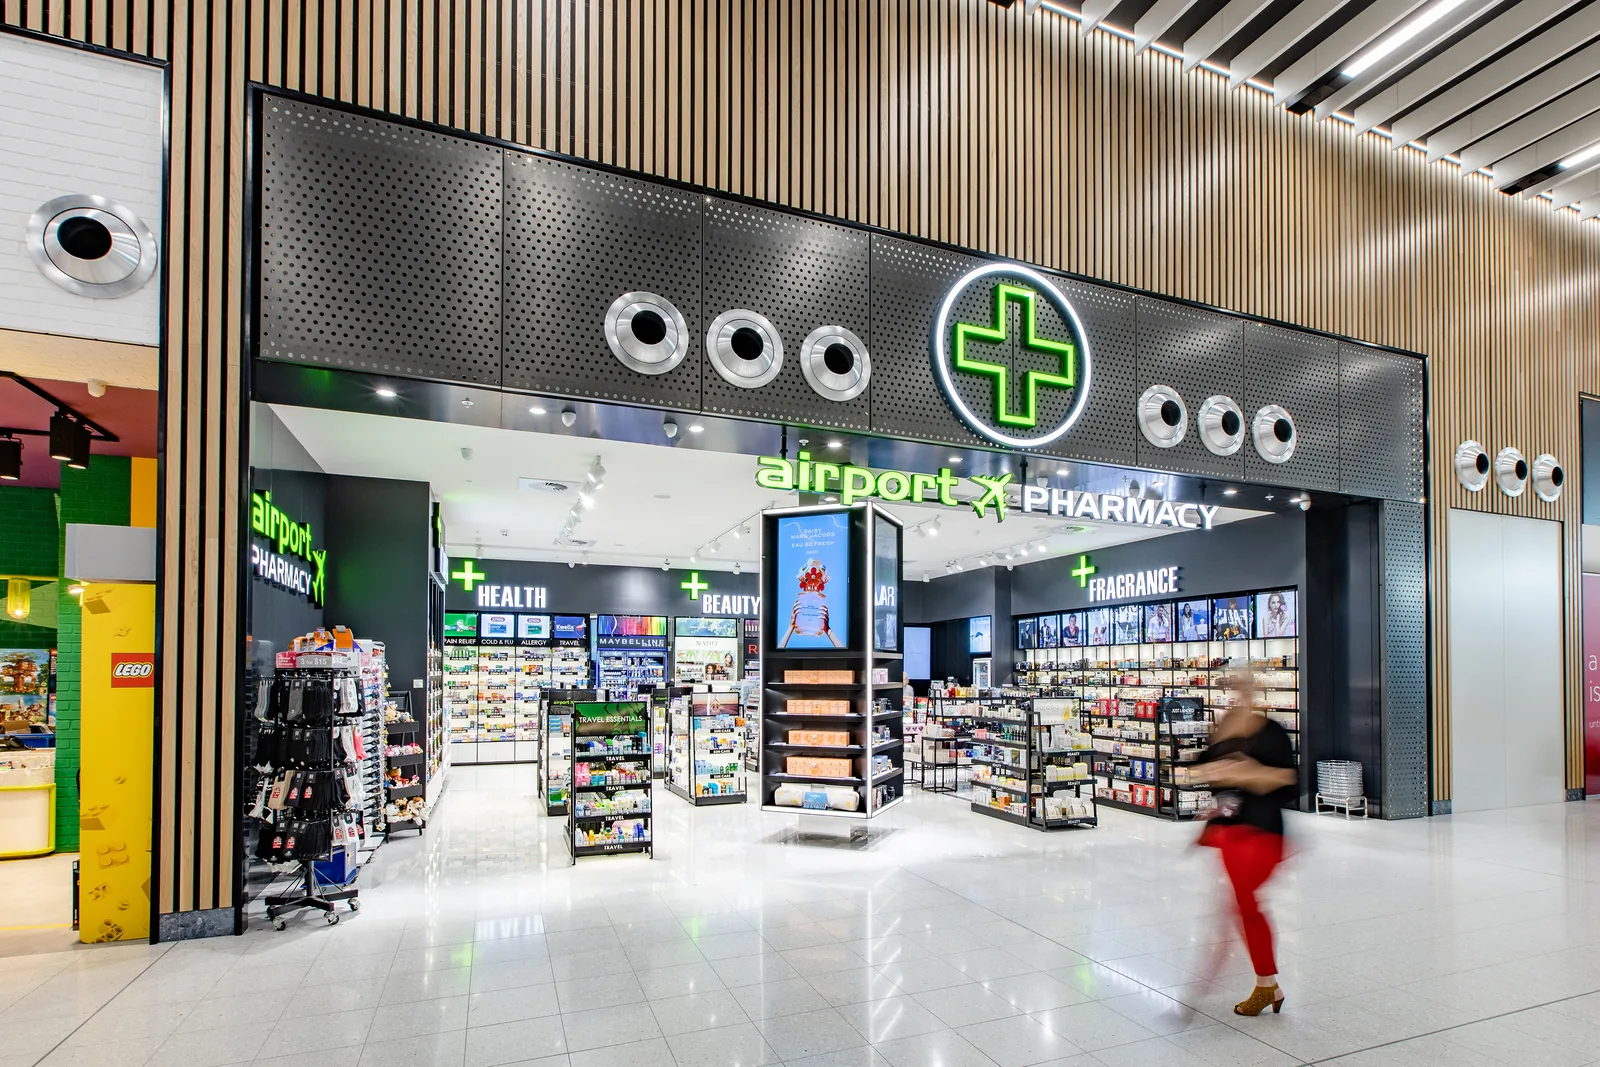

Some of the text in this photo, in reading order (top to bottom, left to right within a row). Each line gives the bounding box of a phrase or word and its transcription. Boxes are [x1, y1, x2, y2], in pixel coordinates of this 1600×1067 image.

[756, 451, 1219, 530] airport PHARMACY
[252, 490, 312, 562] airport
[1089, 566, 1179, 602] FRAGRANCE
[478, 585, 547, 608] HEALTH
[702, 594, 760, 615] BEAUTY
[113, 662, 153, 678] LEGO
[314, 657, 327, 665] $15
[1588, 654, 1598, 671] a
